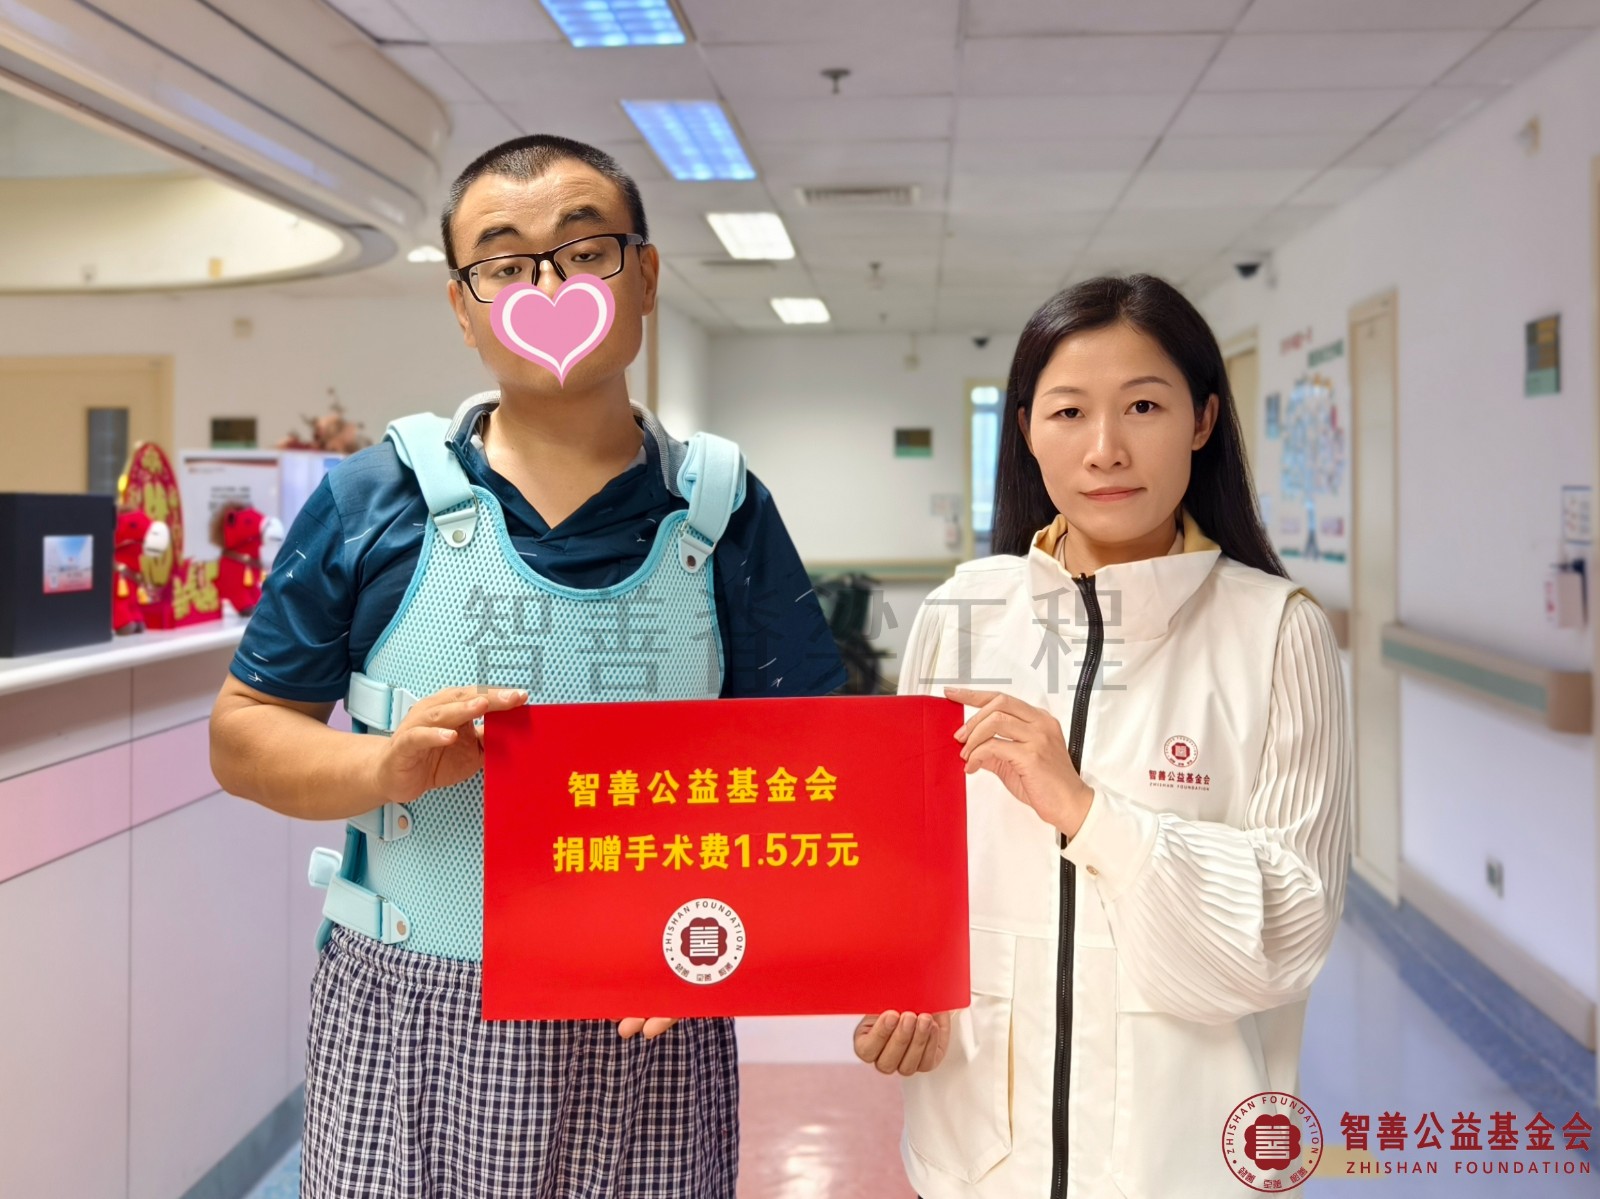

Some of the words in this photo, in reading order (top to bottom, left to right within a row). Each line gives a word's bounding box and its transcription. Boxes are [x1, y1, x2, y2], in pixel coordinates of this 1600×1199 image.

[567, 766, 838, 808] 智善公益基金会
[552, 833, 860, 873] 捐赠手术费1.5万元
[665, 905, 691, 953] ZHISHAN
[695, 900, 744, 952] FOUNDATION
